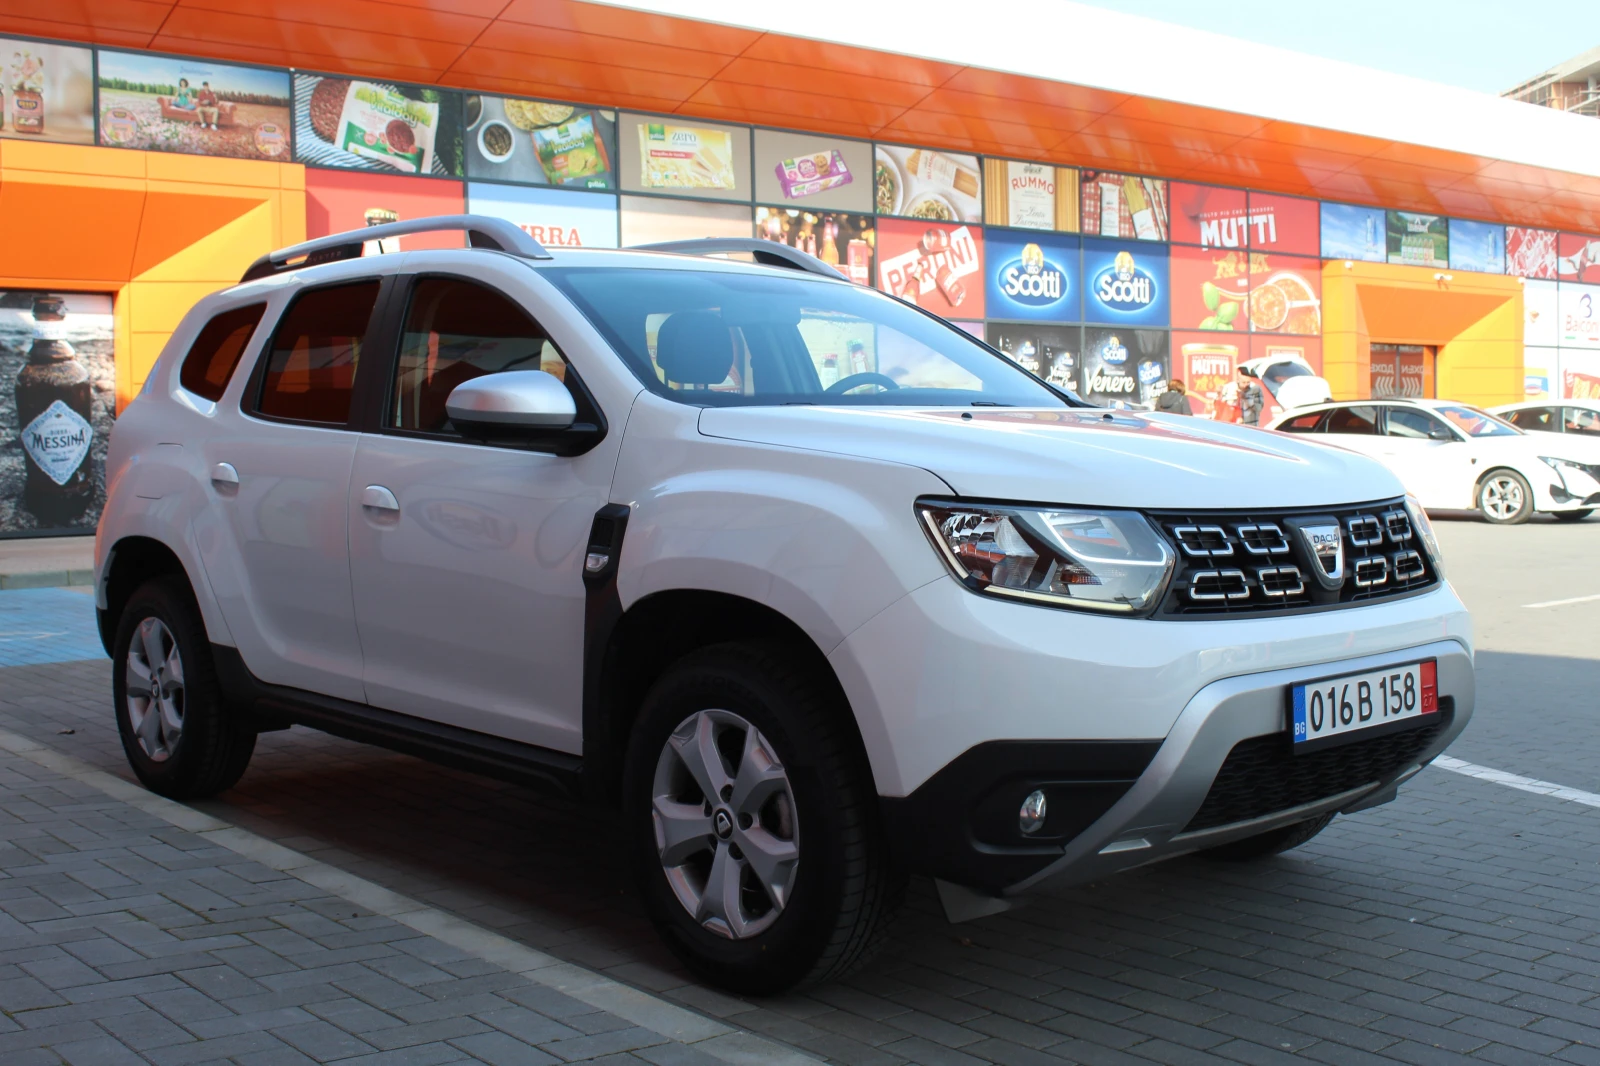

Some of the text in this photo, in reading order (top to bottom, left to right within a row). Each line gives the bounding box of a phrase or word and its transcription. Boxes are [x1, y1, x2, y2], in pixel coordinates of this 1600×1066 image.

[1011, 176, 1056, 195] RUMMO
[520, 224, 582, 246] RRA
[1200, 213, 1277, 251] MUTTI
[1005, 267, 1060, 299] Scotti
[1100, 274, 1150, 304] Scotti
[1102, 346, 1127, 361] Scotti
[1191, 358, 1230, 375] MUTTI
[1083, 363, 1136, 396] Venere
[31, 427, 86, 451] MESSINA
[1313, 533, 1339, 544] DACIA
[1295, 721, 1306, 736] BG
